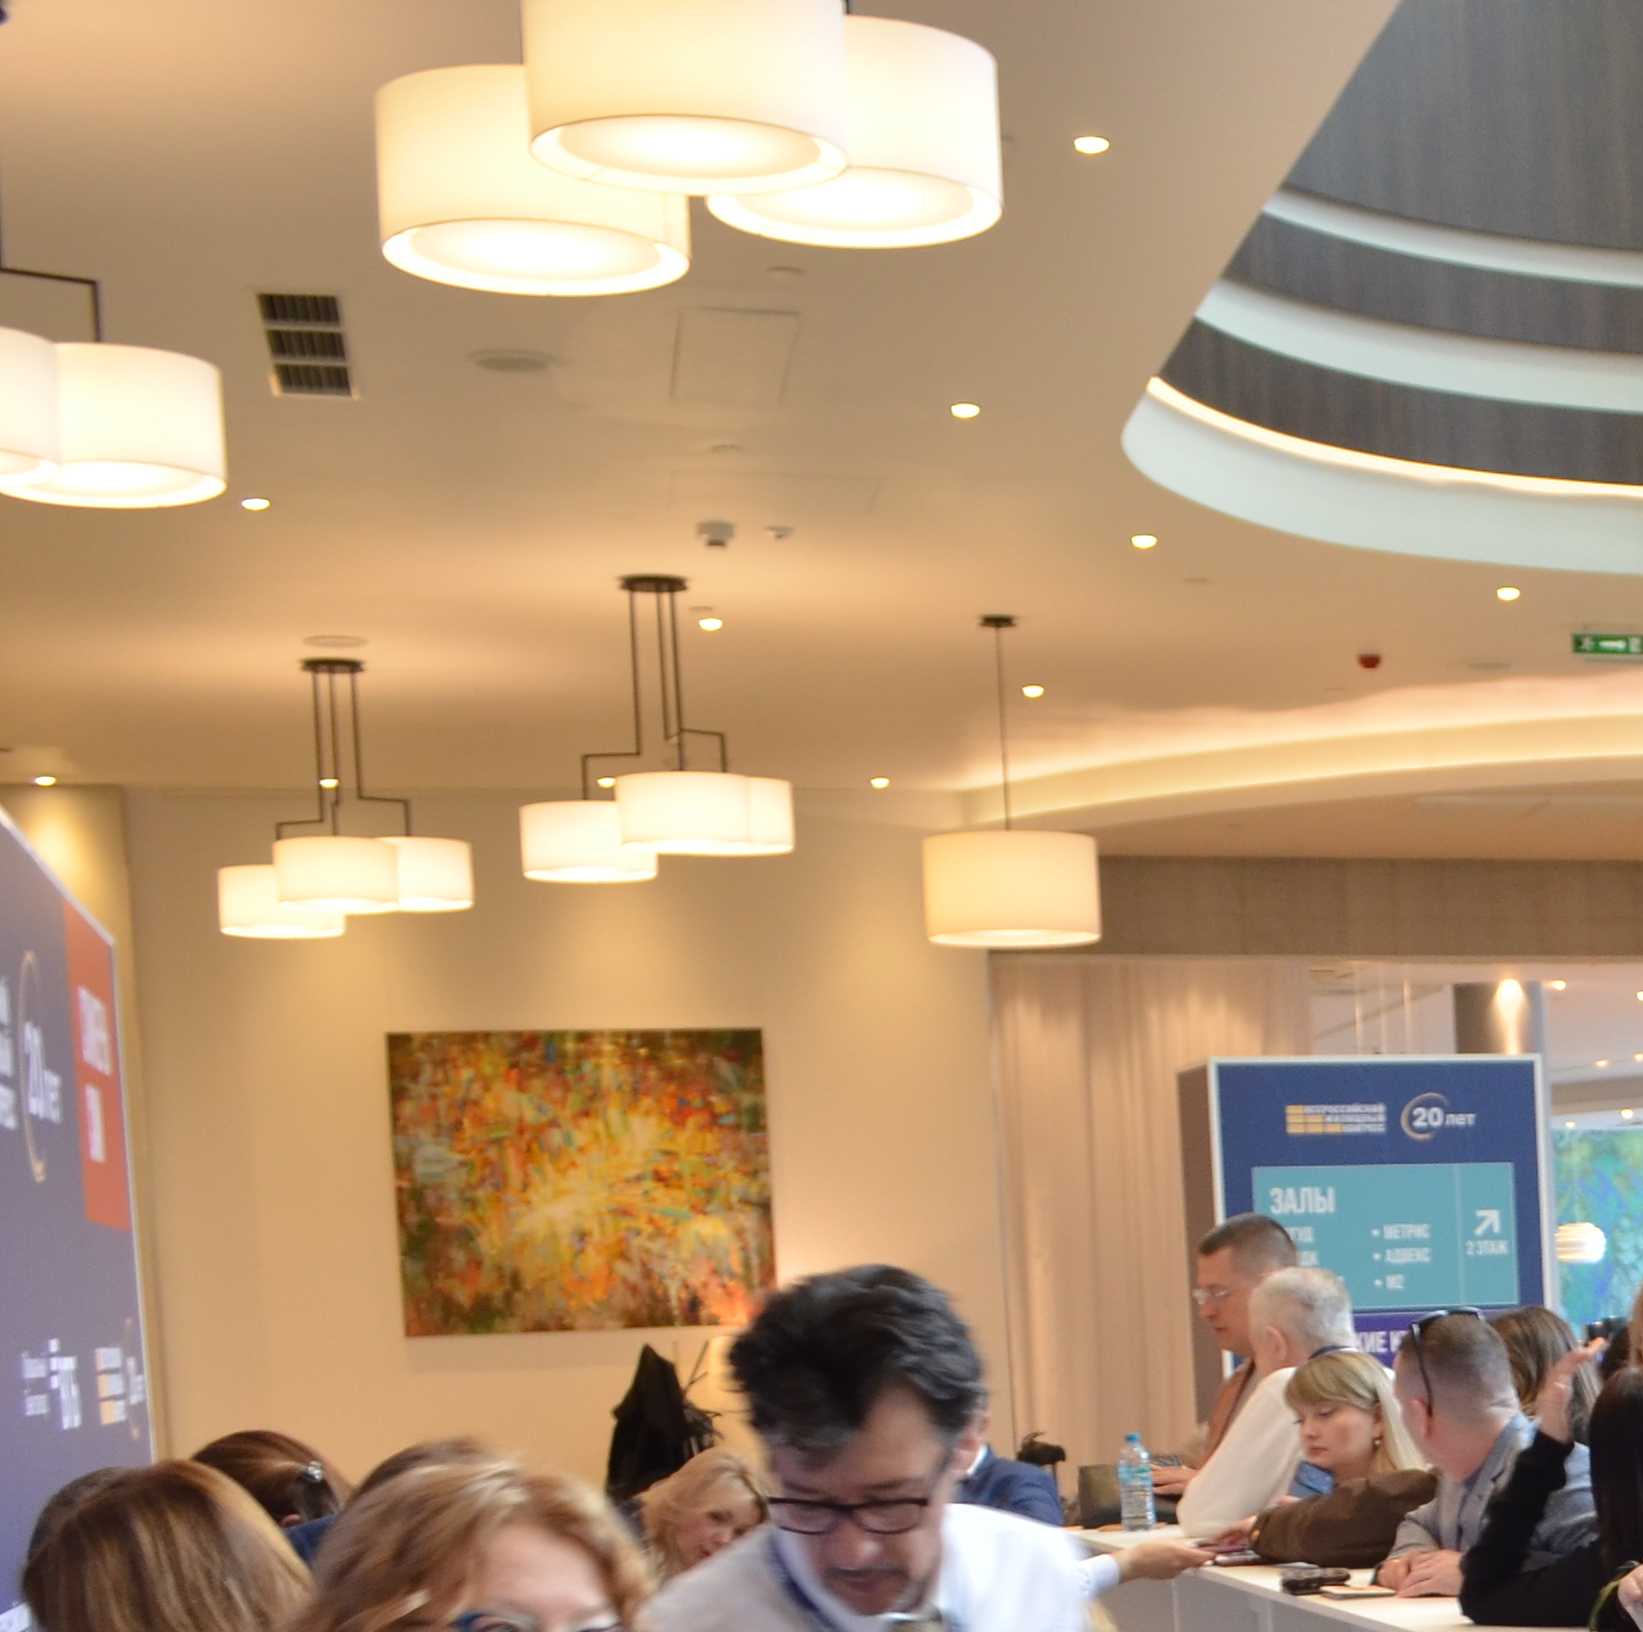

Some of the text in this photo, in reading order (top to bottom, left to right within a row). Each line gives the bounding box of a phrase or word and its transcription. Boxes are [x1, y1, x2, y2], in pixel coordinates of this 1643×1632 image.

[1412, 1106, 1477, 1128] 20 лет
[1269, 1186, 1336, 1215] ЗАЛЫ
